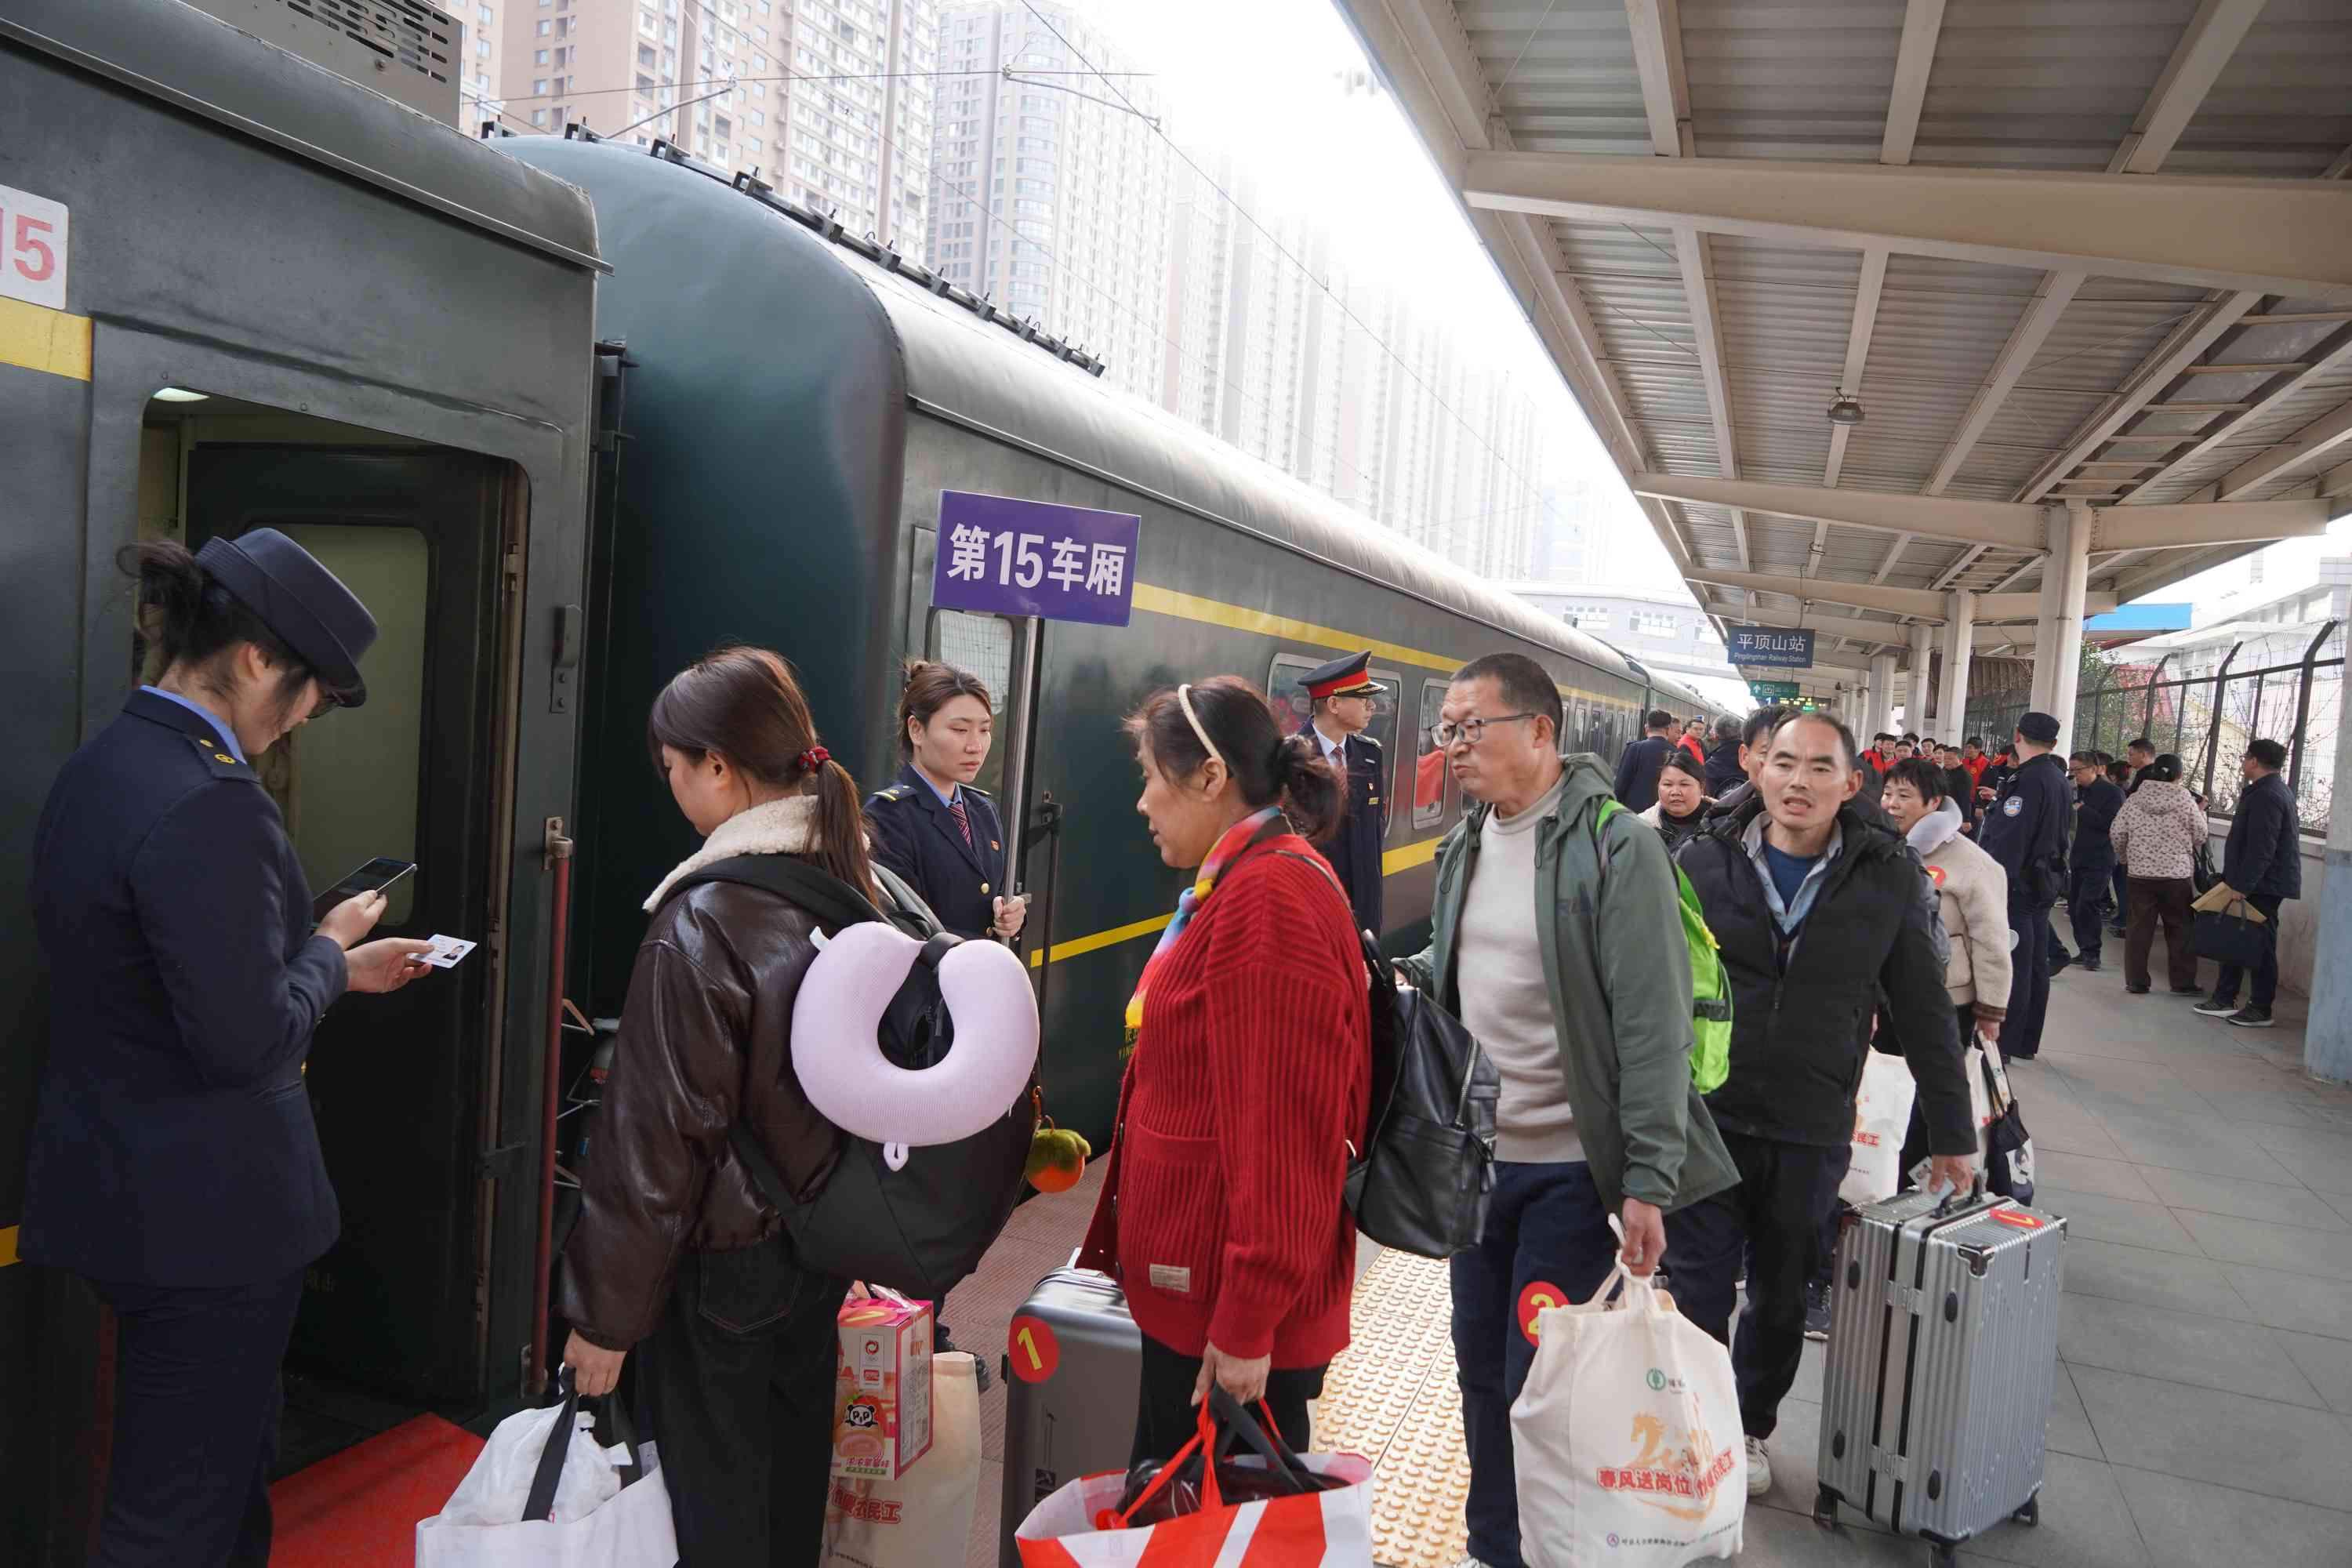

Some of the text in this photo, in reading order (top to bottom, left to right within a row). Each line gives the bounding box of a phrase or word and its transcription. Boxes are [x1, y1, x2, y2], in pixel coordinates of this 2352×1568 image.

[947, 523, 1127, 596] 第15车厢
[1737, 633, 1806, 652] 平顶山站
[1768, 654, 1788, 662] Railway
[1528, 1293, 1556, 1334] 2
[1017, 1327, 1043, 1370] 1
